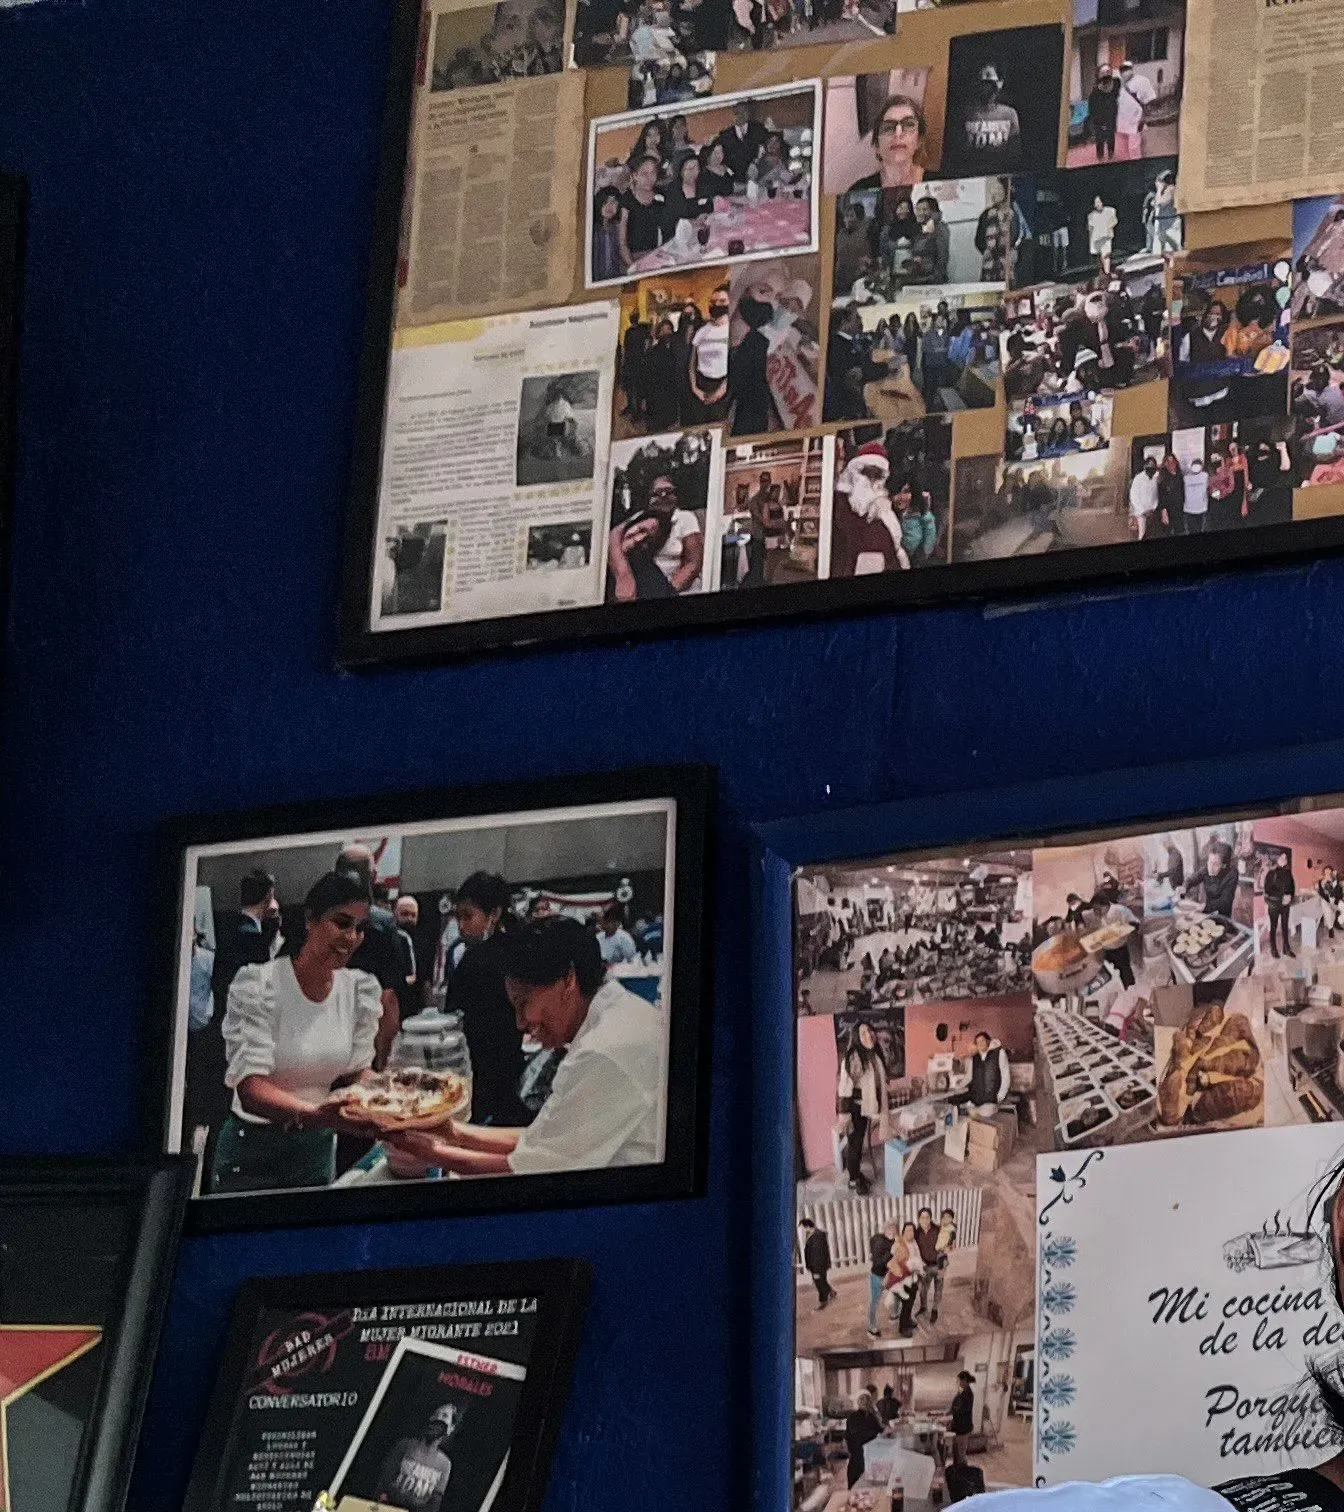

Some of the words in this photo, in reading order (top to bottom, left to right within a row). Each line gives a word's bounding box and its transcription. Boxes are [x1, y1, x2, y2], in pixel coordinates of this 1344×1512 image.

[497, 1299, 518, 1315] DE
[520, 1297, 538, 1313] LA
[1148, 1286, 1210, 1324] Mi
[1222, 1285, 1324, 1319] cocina
[1199, 1321, 1238, 1356] de
[1252, 1316, 1288, 1351] la
[250, 1391, 358, 1410] CONVERSATORIO
